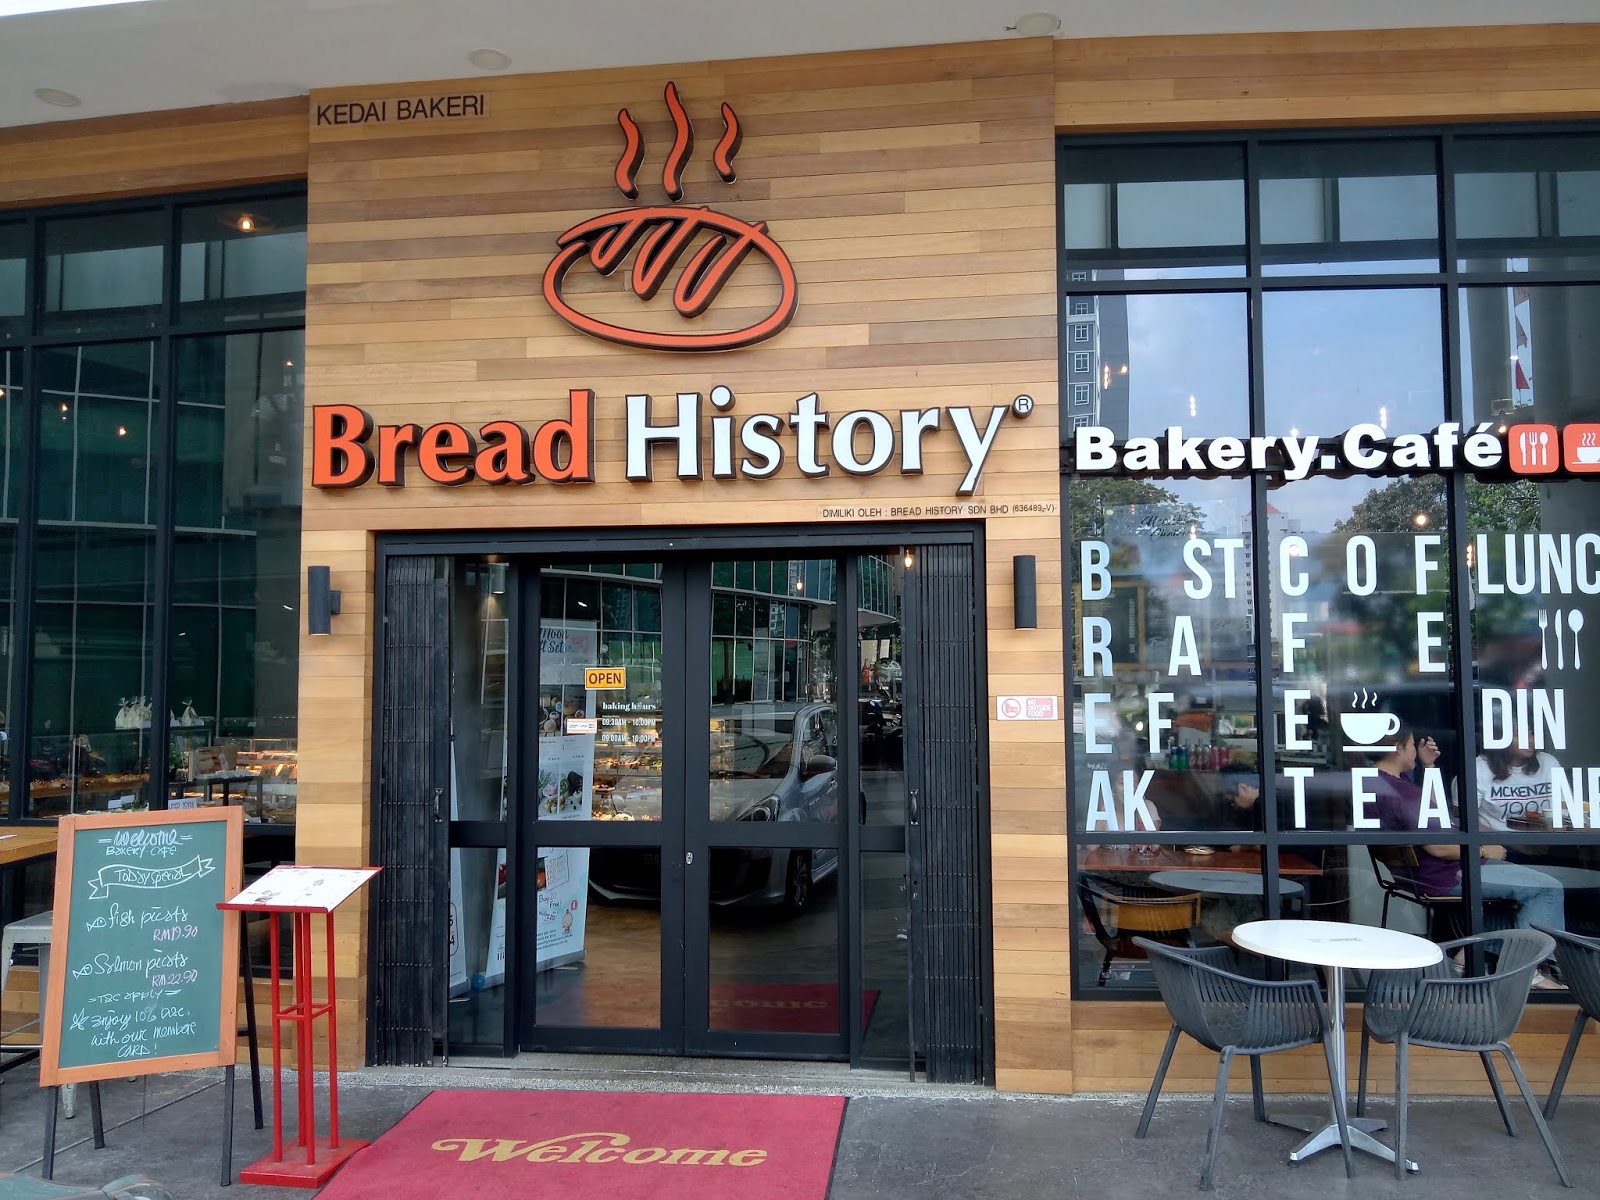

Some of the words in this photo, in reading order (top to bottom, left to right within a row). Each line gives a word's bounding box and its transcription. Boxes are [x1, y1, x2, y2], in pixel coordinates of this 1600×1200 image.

[316, 101, 386, 126] KEDAI
[397, 95, 484, 121] BAKERI
[312, 388, 595, 490] Bread
[625, 385, 1010, 497] History
[822, 509, 855, 518] DIMILIKI
[858, 508, 882, 518] OLEH
[890, 507, 922, 516] BREAD
[925, 505, 963, 516] HISTORY
[967, 504, 987, 515] SDN
[989, 504, 1009, 514] BHD
[588, 673, 622, 685] OPEN
[602, 702, 630, 712] baking
[431, 1131, 768, 1167] Welcome
